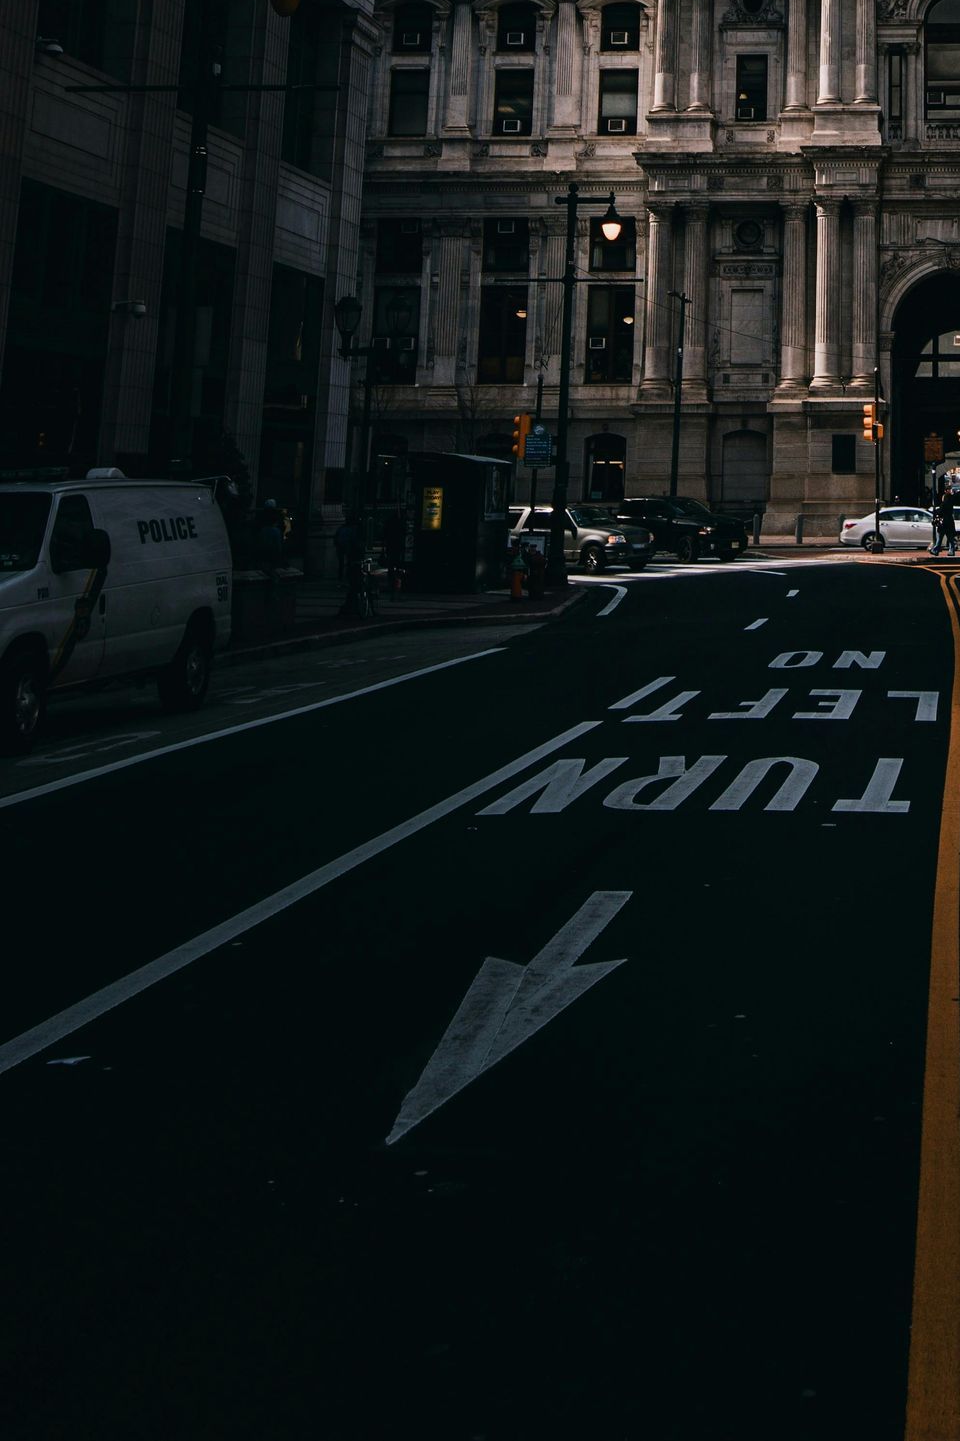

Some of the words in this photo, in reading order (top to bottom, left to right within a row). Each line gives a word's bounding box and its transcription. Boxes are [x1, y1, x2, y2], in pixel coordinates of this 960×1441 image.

[137, 516, 198, 545] POLICE
[217, 586, 229, 602] 911
[768, 650, 887, 669] NO
[621, 688, 940, 722] LEFT
[474, 755, 911, 816] TURN
